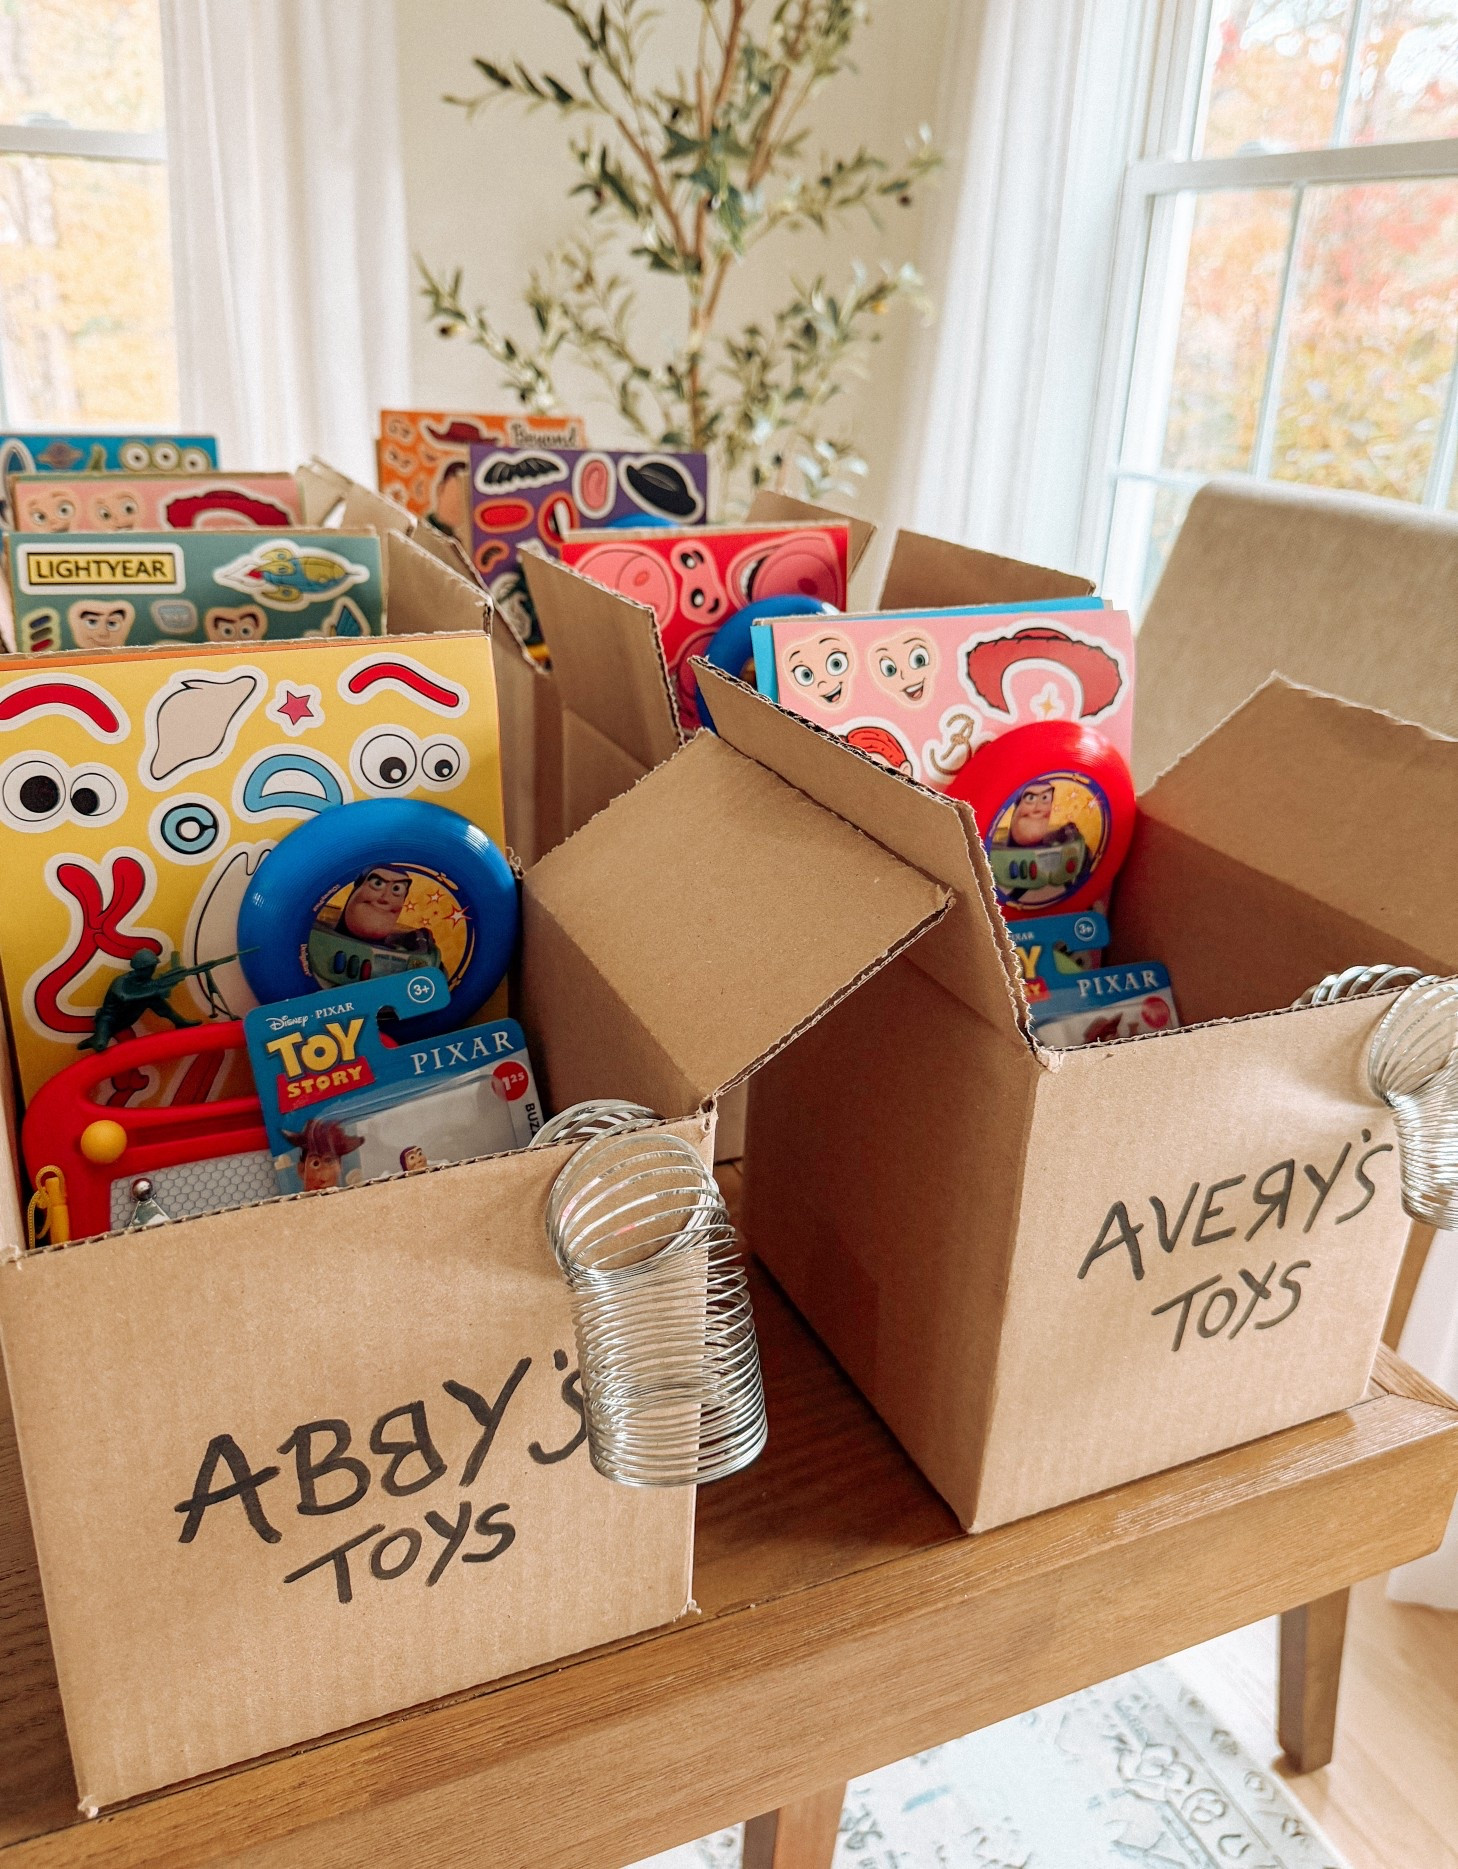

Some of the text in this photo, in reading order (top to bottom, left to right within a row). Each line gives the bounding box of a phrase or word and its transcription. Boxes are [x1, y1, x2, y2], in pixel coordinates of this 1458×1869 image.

[36, 560, 167, 579] LIGHTYEAR
[1078, 924, 1092, 934] 3+
[413, 983, 431, 996] 3+
[1077, 969, 1160, 998] PIXAR
[314, 1002, 355, 1020] PIXAR
[265, 1017, 366, 1079] TOY
[410, 1031, 515, 1076] PIXAR
[286, 1065, 363, 1099] STORY
[1150, 1260, 1312, 1352] TOYS
[283, 1500, 517, 1604] TOYS
